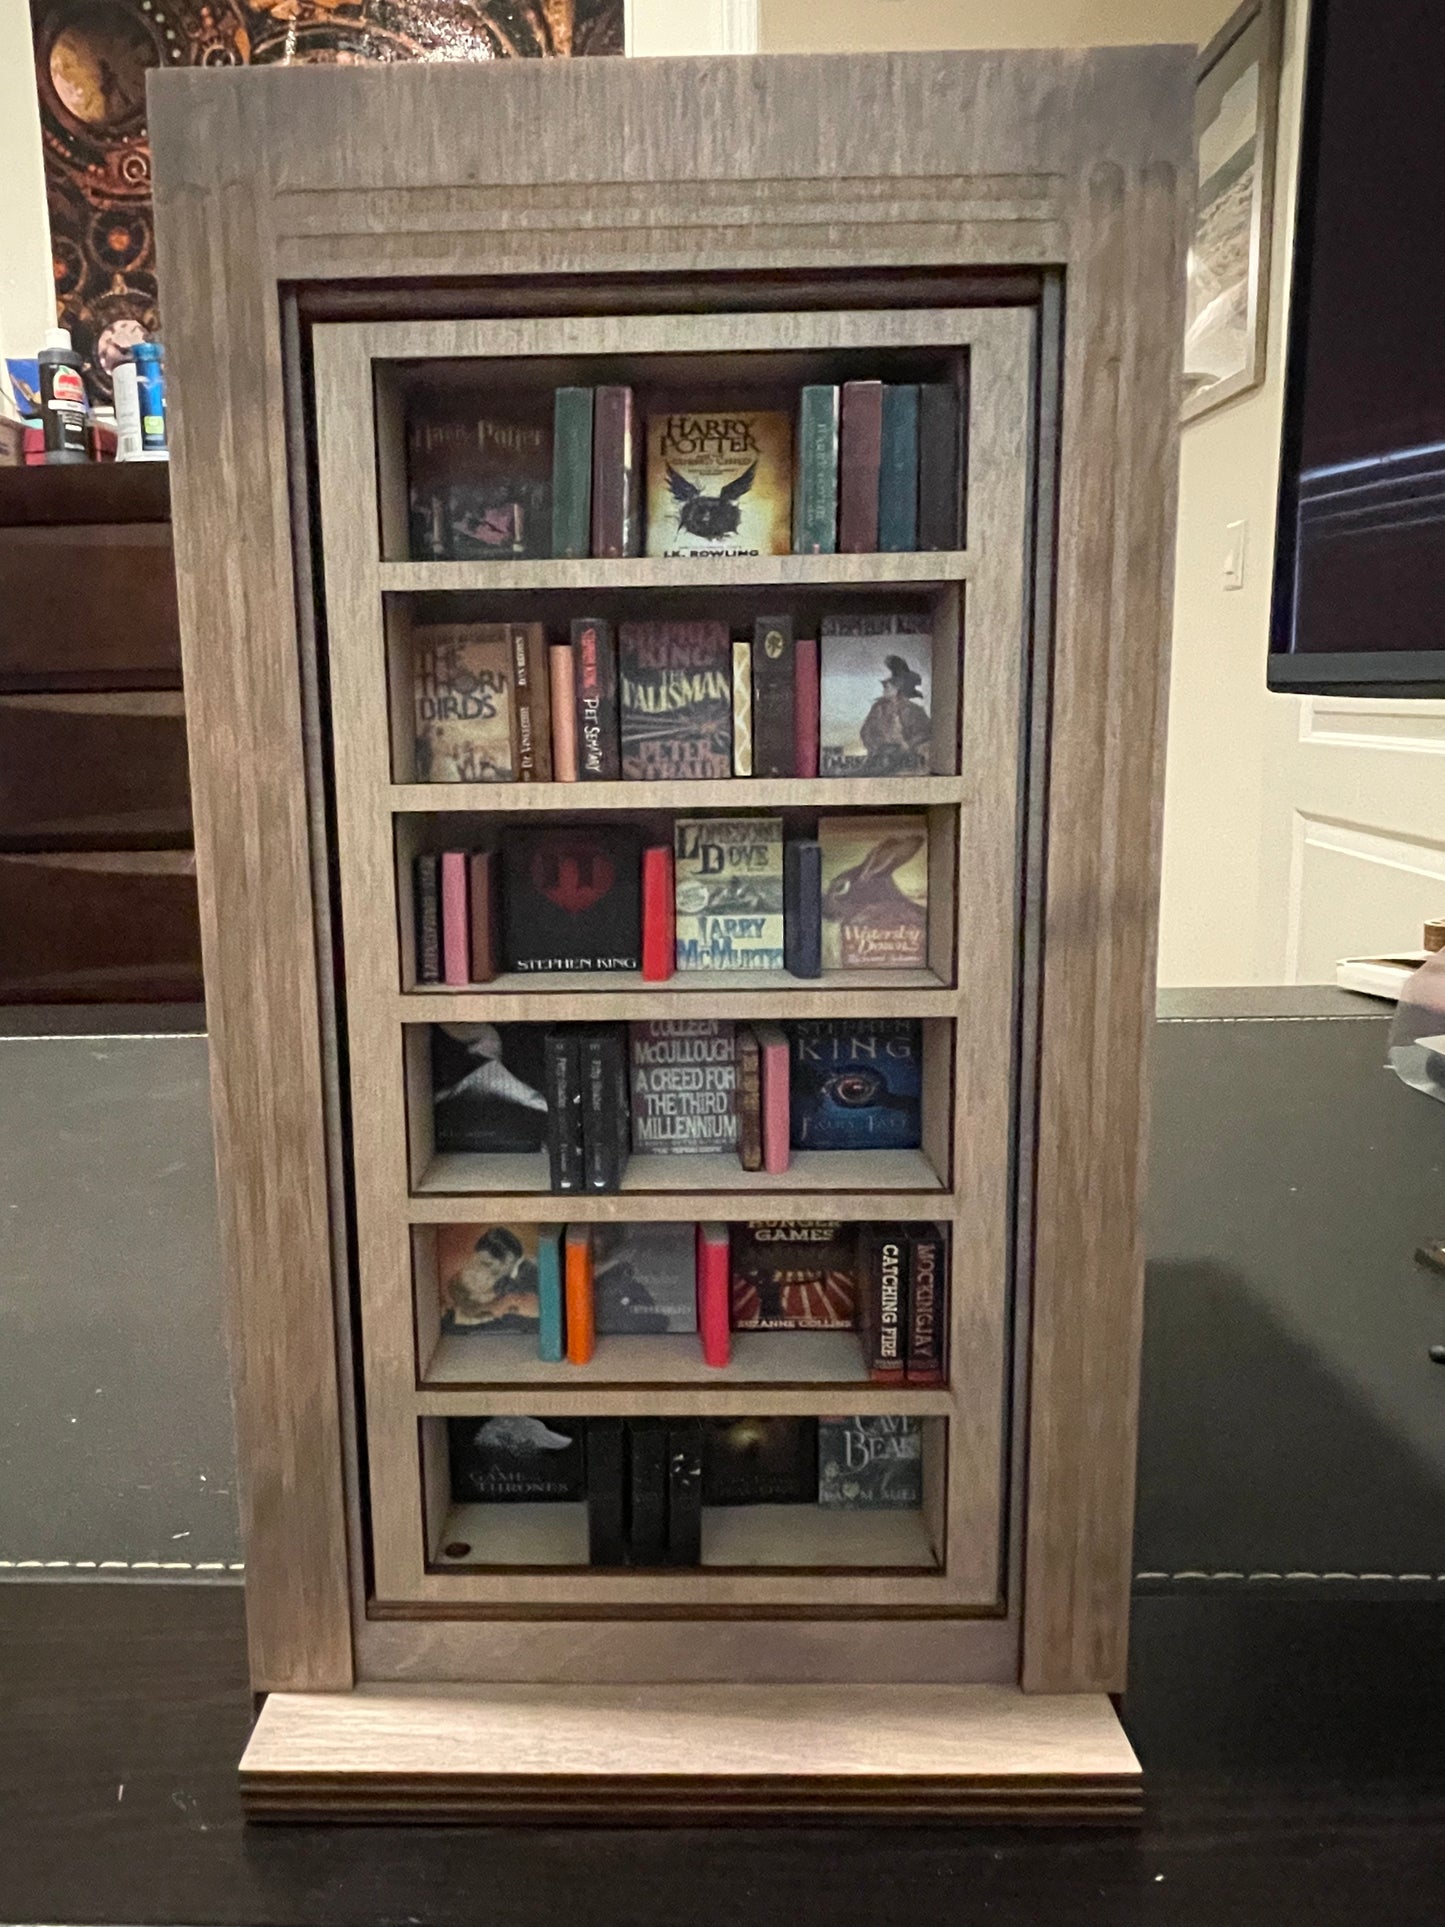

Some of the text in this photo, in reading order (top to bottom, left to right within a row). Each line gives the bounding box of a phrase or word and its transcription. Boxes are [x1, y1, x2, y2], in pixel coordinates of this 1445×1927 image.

[666, 415, 756, 439] HARRY
[660, 434, 761, 456] POTTER
[690, 549, 760, 558] ROWLING
[620, 670, 731, 714] TALISMAN
[417, 694, 498, 721] BIRDS
[583, 695, 600, 725] PET
[517, 957, 637, 970] STEPHEN KING
[798, 1036, 912, 1060] KING
[635, 1066, 736, 1093] A CREED FOR
[643, 1092, 729, 1116] THE THIRD
[637, 1114, 738, 1140] MILLENNIUM
[754, 1228, 835, 1242] GAMES
[882, 1244, 899, 1324] CATCHING
[913, 1243, 936, 1358] MOCKINGJAY
[881, 1327, 898, 1358] FIRE
